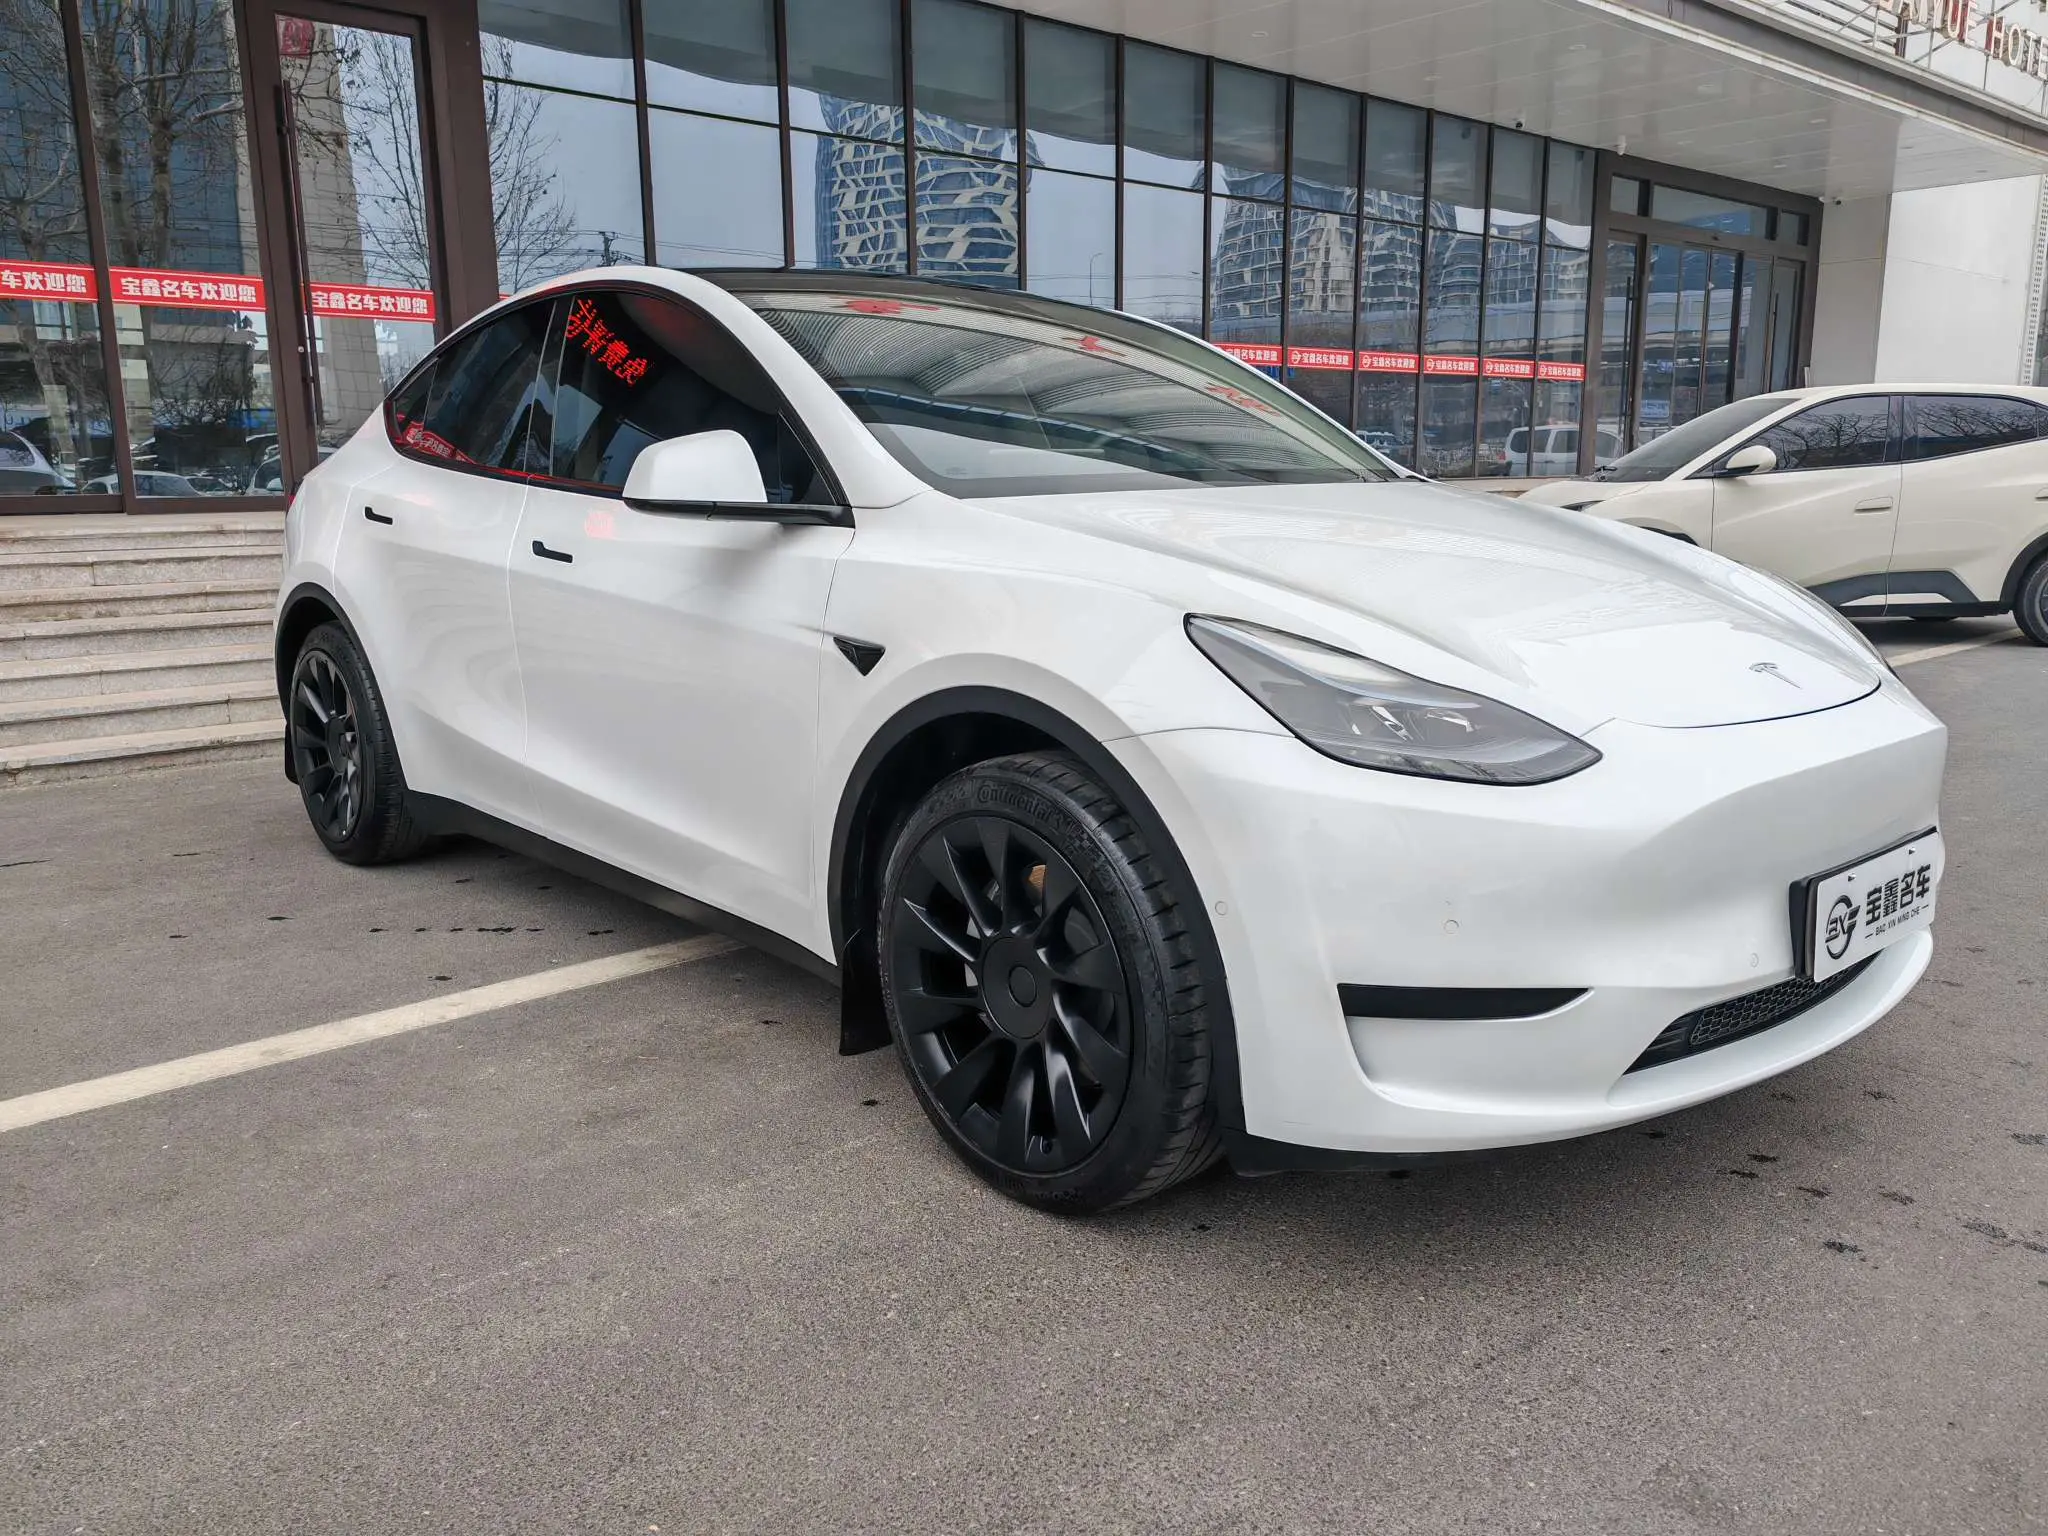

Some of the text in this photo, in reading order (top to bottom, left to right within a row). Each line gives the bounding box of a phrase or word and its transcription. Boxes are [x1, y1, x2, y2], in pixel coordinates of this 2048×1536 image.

[1, 269, 87, 293] 车欢迎您
[120, 277, 257, 303] 宝鑫名车欢迎您
[311, 291, 428, 314] 宝鑫名车欢迎您
[1866, 864, 1931, 926] 宝鑫名车
